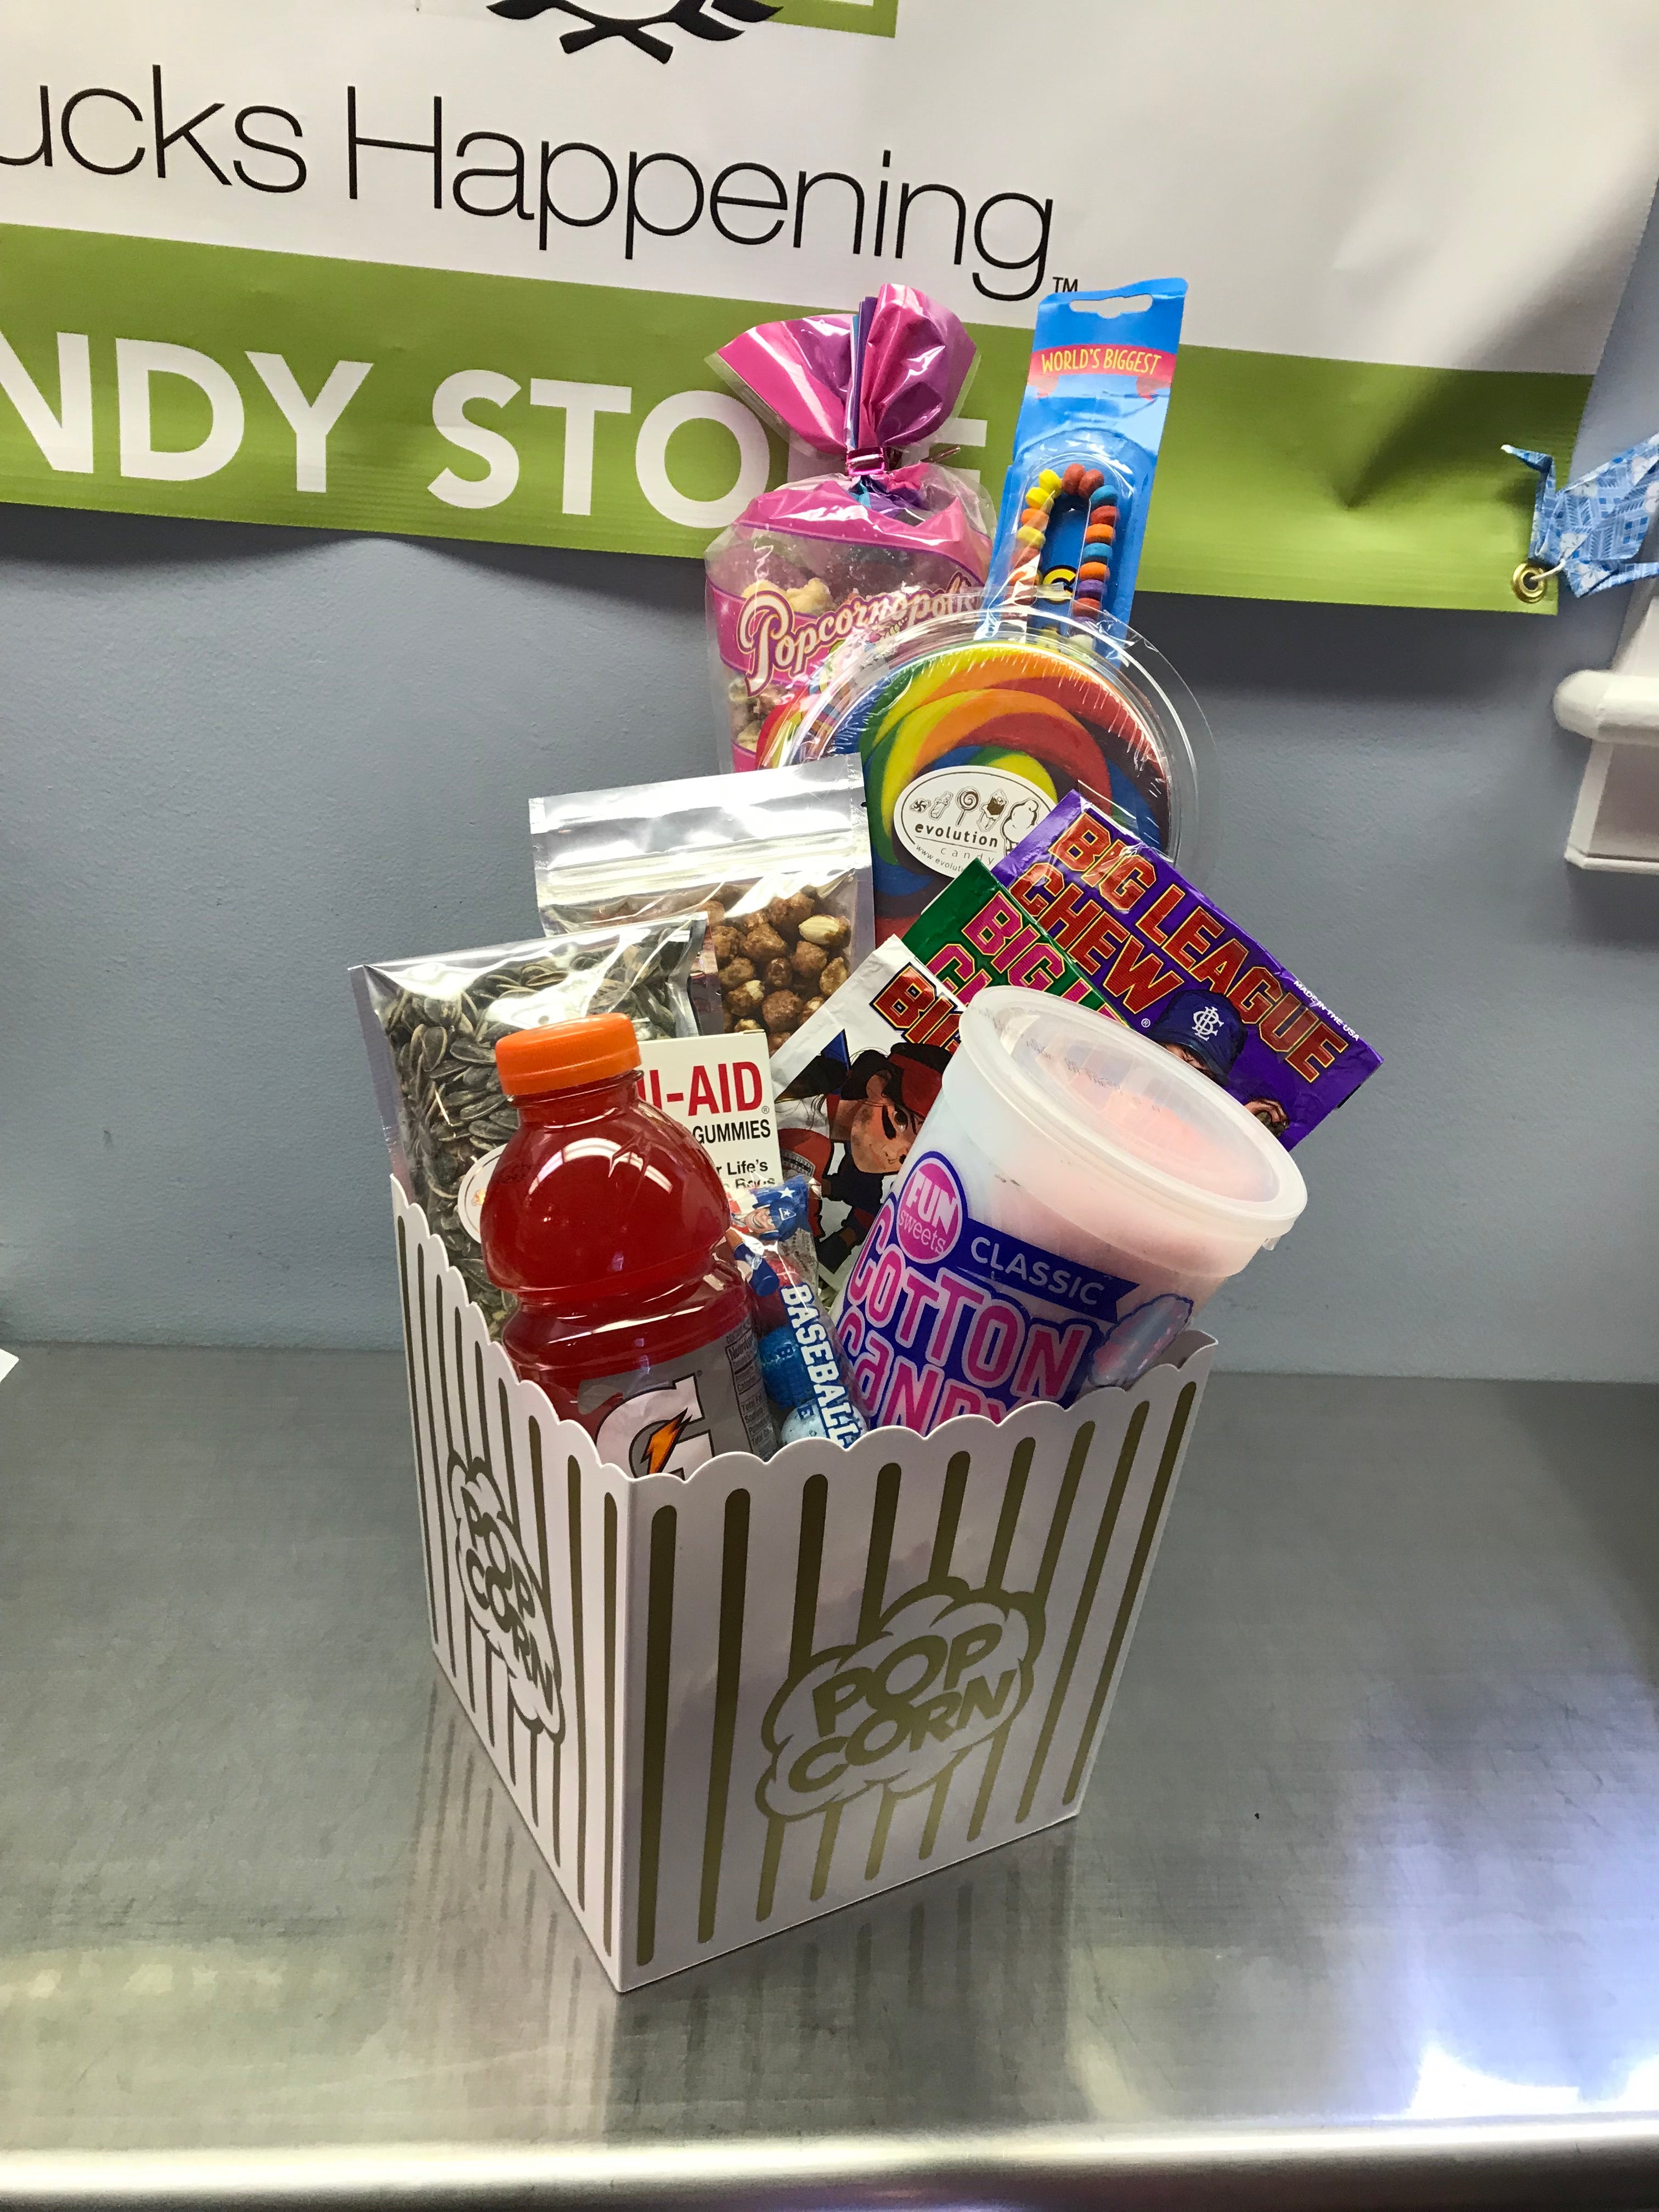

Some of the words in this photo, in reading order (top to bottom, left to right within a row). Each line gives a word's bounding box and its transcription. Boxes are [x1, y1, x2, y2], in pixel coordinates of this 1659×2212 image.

[347, 86, 1054, 302] Happening
[0, 331, 375, 494] NDY
[1041, 348, 1101, 374] WORLD'S
[1103, 348, 1162, 375] BIGGEST
[915, 823, 998, 848] evolution
[961, 890, 1065, 992] BIG
[1009, 862, 1185, 1015] CHEW
[1048, 811, 1156, 911] BIG
[1135, 883, 1349, 1084] LEAGUE
[1293, 980, 1318, 1003] MADE
[1327, 1009, 1344, 1026] THE
[1342, 1024, 1360, 1042] USA
[692, 1119, 771, 1144] GUMMIES
[727, 1159, 769, 1176] Life's
[899, 1209, 946, 1254] sweets
[905, 1170, 958, 1235] FUN
[847, 1198, 1093, 1401] COTTON
[970, 1236, 1105, 1305] CLASSIC
[780, 1284, 861, 1447] BASEBALL
[460, 1486, 535, 1620] POP
[465, 1548, 554, 1716] CORN
[812, 1622, 1003, 1737] POP
[788, 1668, 1018, 1793] CORN
